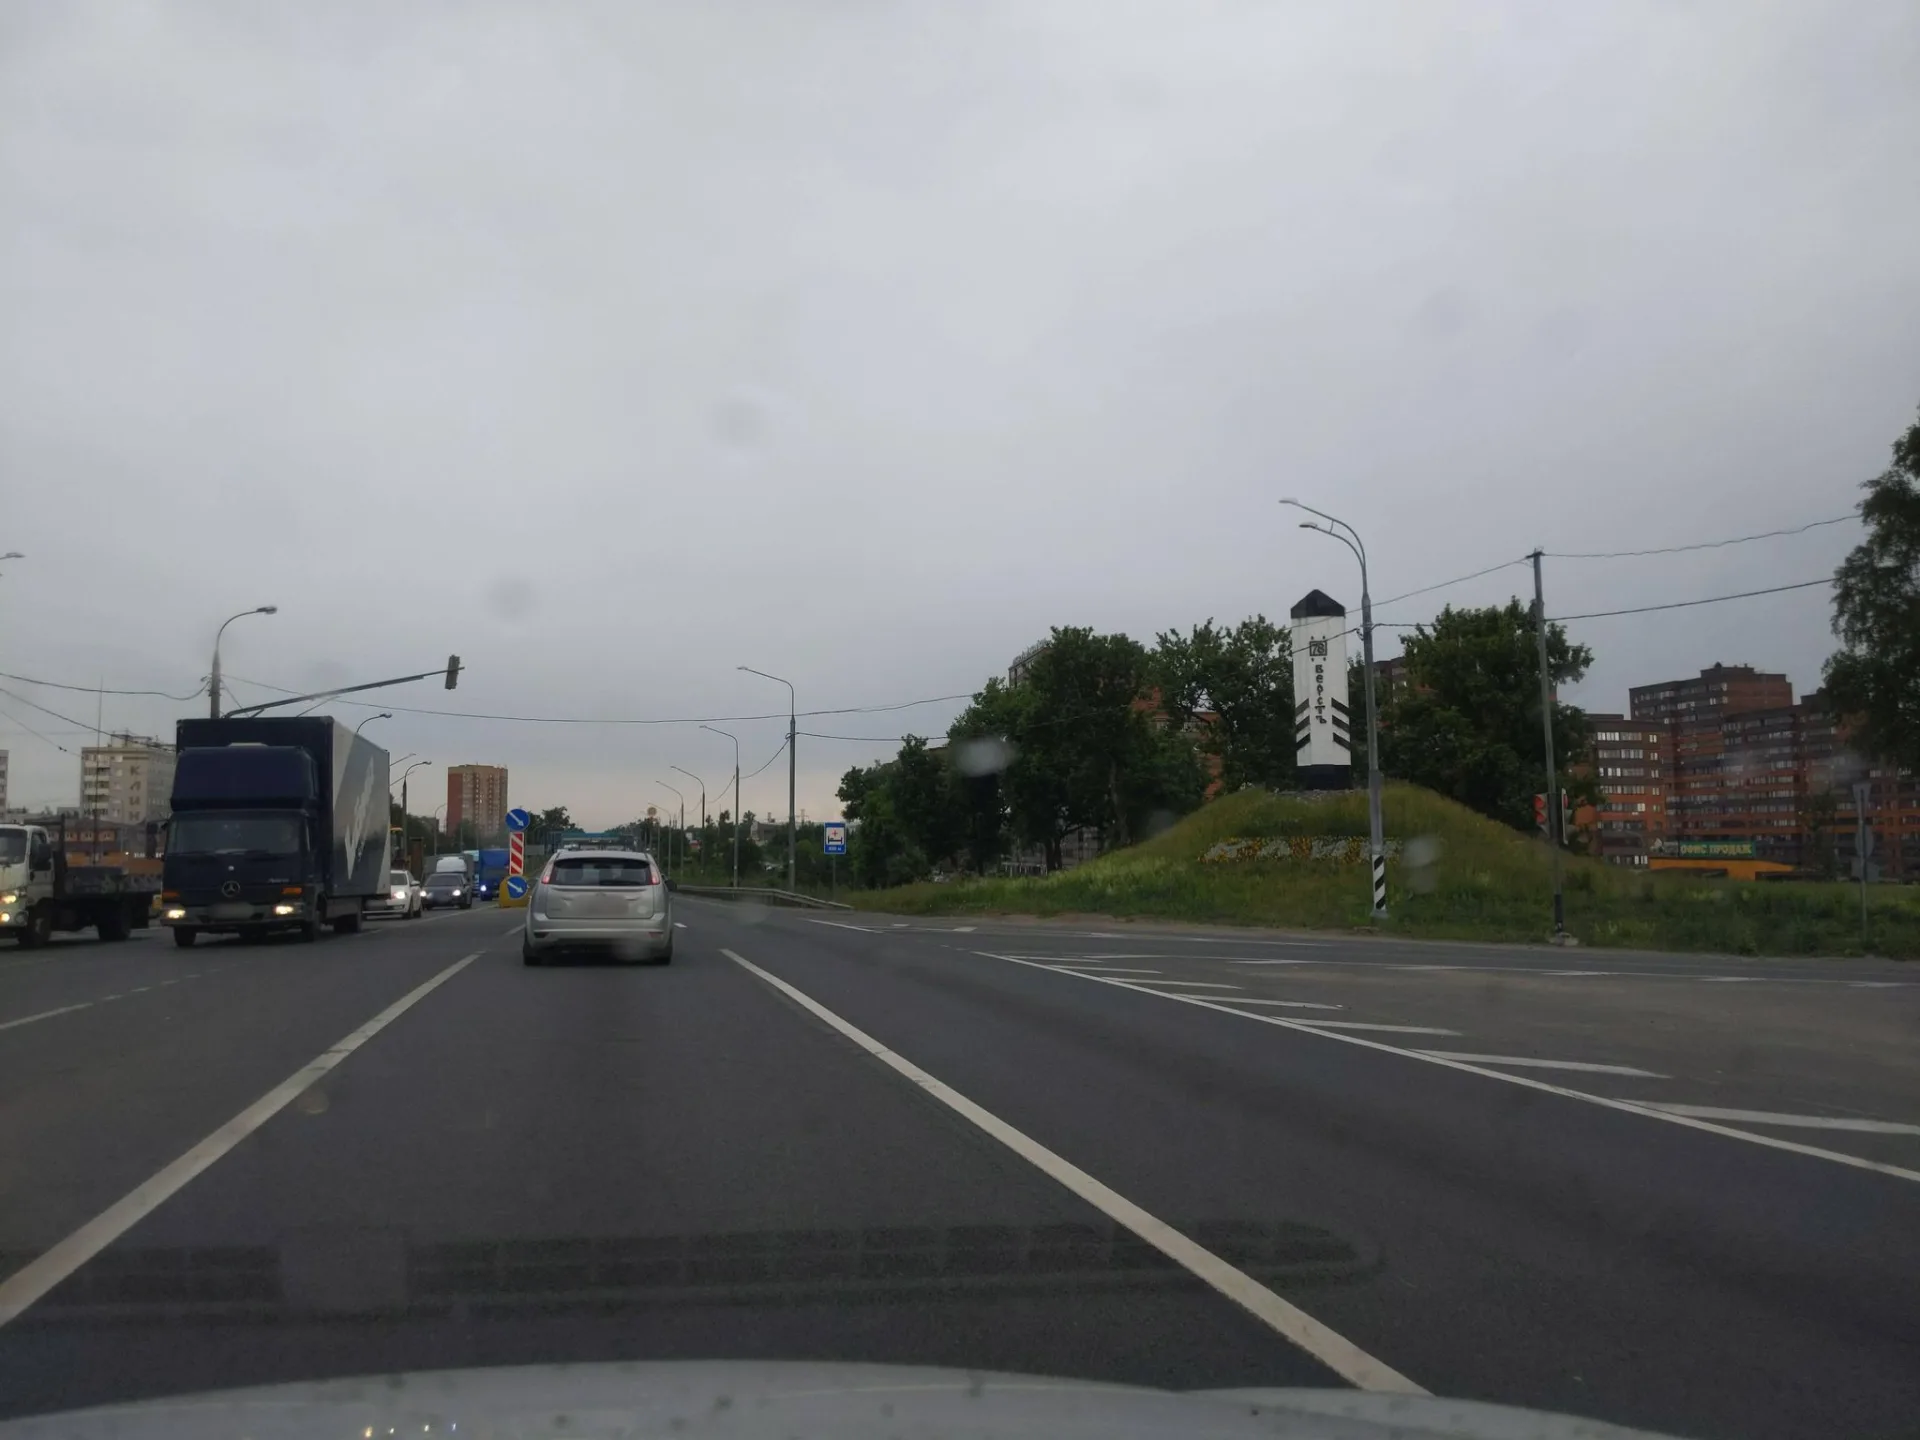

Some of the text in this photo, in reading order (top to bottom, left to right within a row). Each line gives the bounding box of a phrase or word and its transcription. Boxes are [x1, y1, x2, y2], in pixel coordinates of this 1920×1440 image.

[1311, 643, 1325, 655] 78
[129, 765, 142, 821] КЛИН
[1680, 844, 1707, 855] ОФИС
[1709, 844, 1752, 856] ПРОДАЖ
